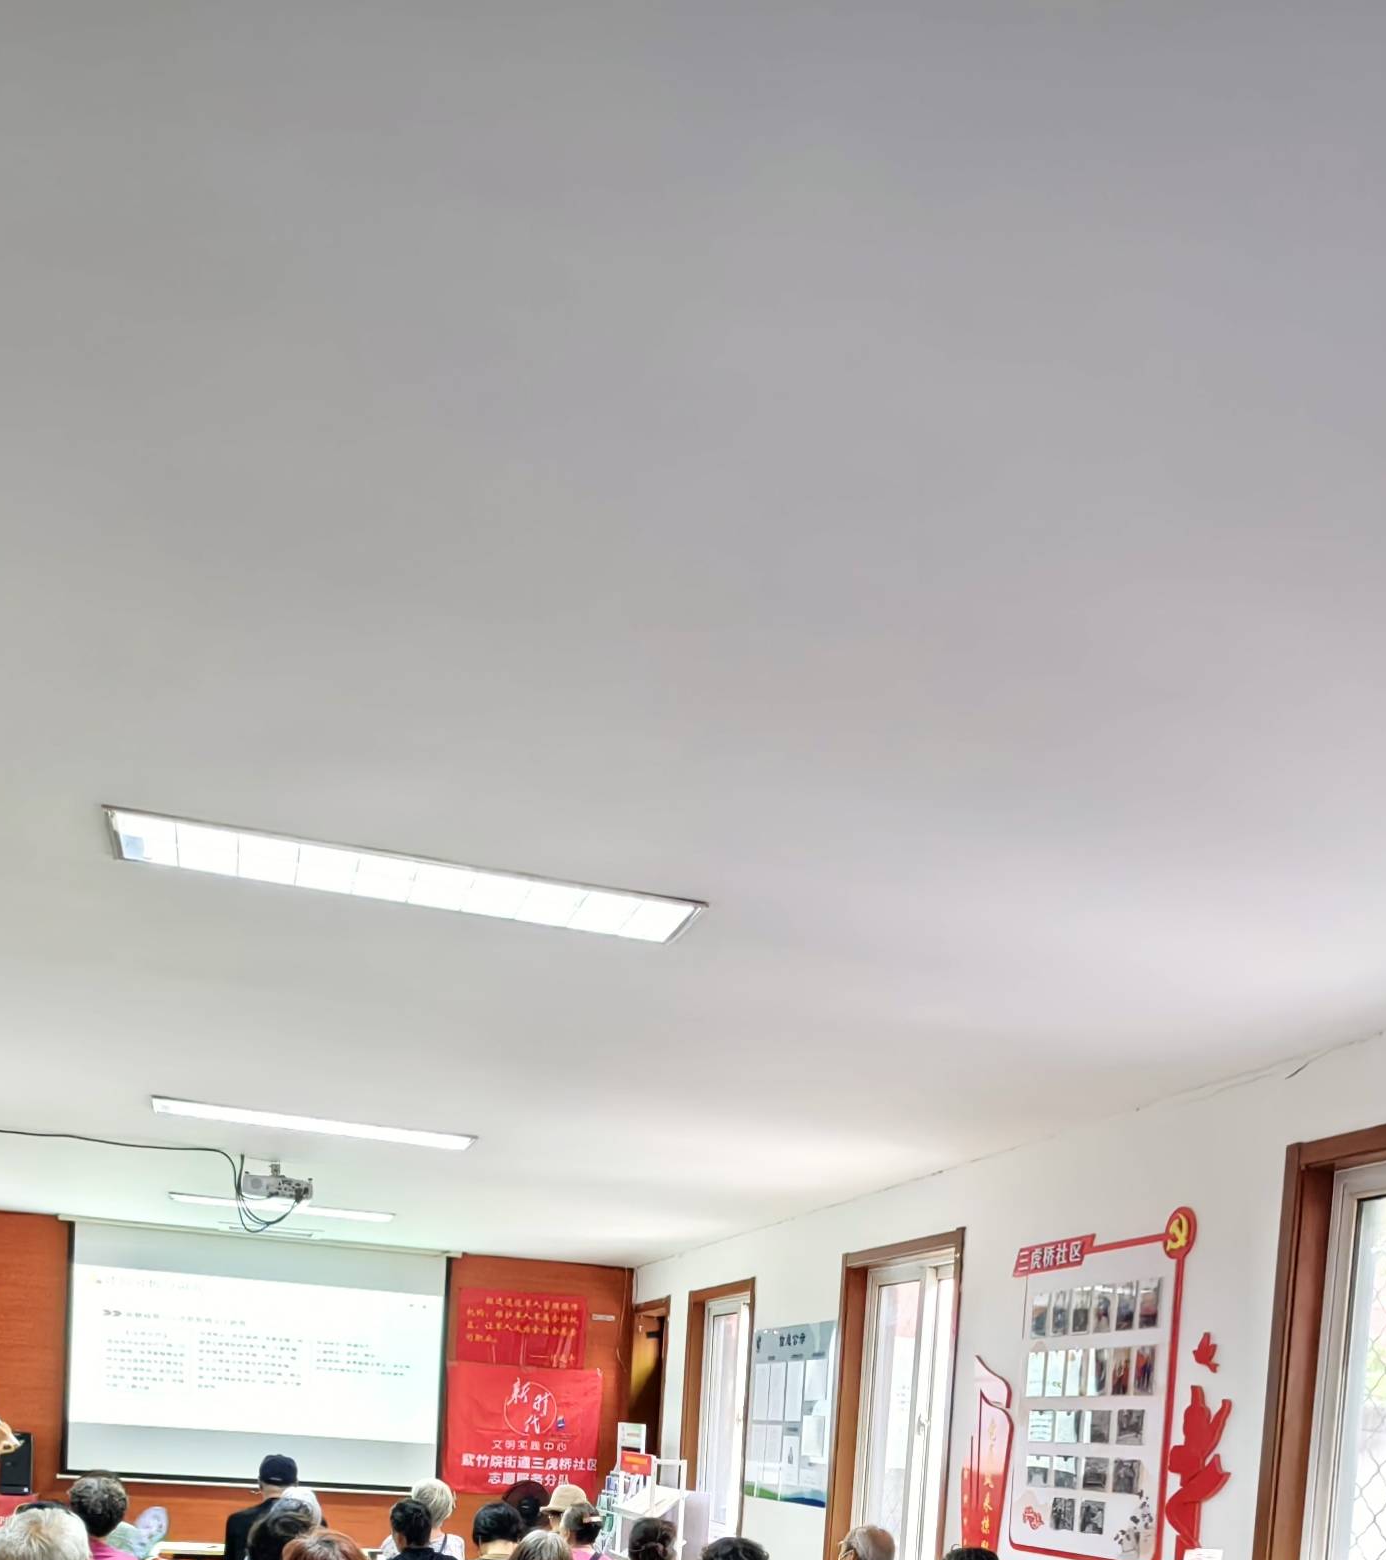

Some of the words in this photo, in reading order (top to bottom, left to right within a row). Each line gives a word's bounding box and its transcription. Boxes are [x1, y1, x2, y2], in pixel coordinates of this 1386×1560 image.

[1018, 1241, 1082, 1270] 三虎桥社区
